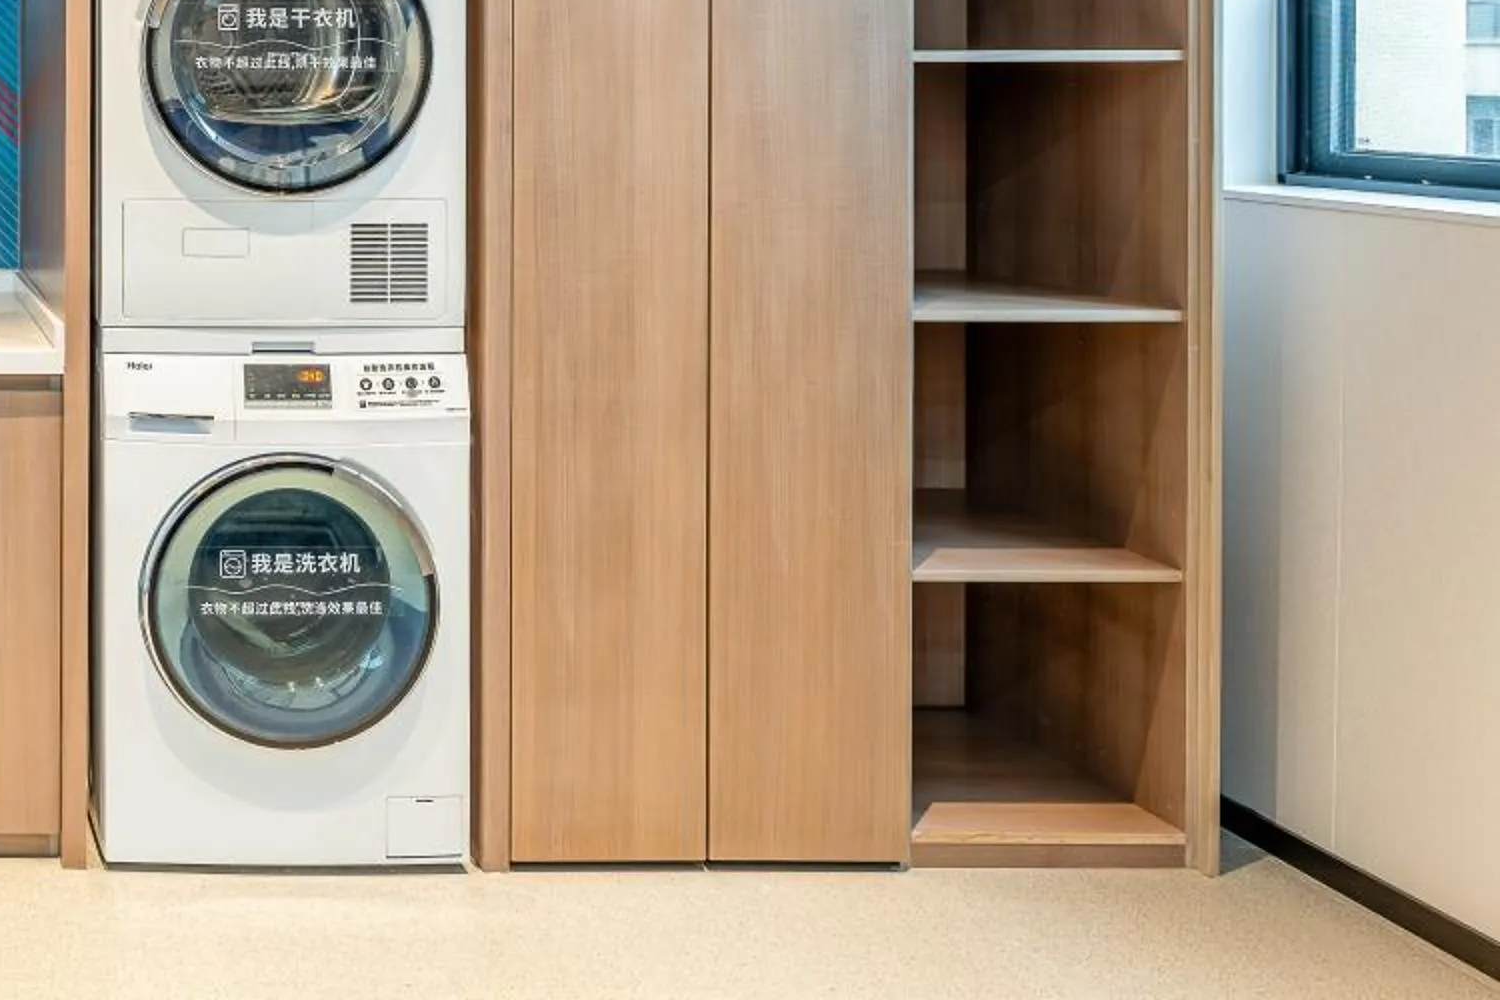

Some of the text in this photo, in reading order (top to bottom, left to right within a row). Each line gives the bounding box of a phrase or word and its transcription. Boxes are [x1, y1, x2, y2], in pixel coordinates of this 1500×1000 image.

[246, 7, 356, 29] 我是干衣机
[251, 552, 361, 574] 我是洗衣机
